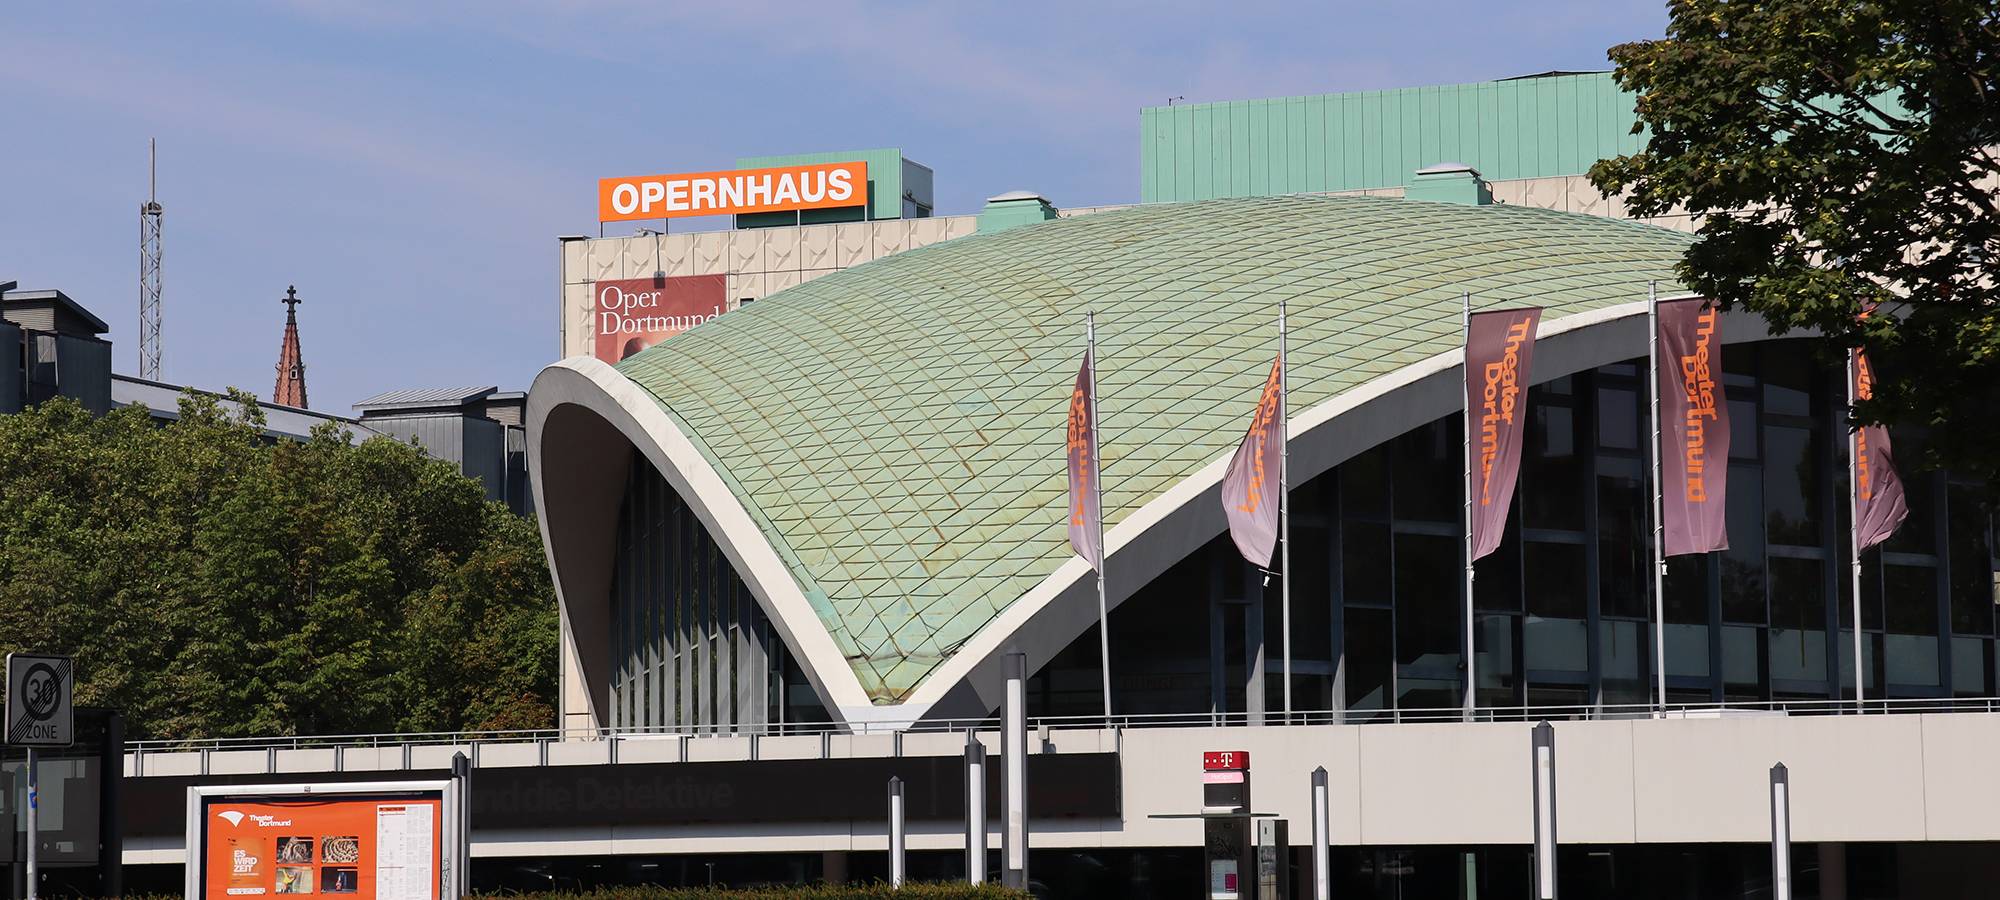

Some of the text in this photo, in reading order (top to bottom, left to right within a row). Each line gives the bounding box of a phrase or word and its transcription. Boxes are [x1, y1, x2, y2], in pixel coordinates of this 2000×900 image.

[611, 168, 853, 215] OPERNHAUS
[600, 286, 661, 316] Oper
[1501, 317, 1531, 426] Theater
[1694, 307, 1718, 421] Theater
[1481, 361, 1503, 506] Dortmu
[1681, 356, 1707, 502] Dortmund
[30, 678, 54, 706] 30
[26, 725, 57, 739] ZONE
[525, 777, 572, 812] die
[575, 775, 736, 811] Detektive
[259, 819, 291, 827] Dortmund
[234, 849, 246, 857] ES
[234, 857, 257, 865] WIRD
[234, 864, 253, 872] ZEIT
